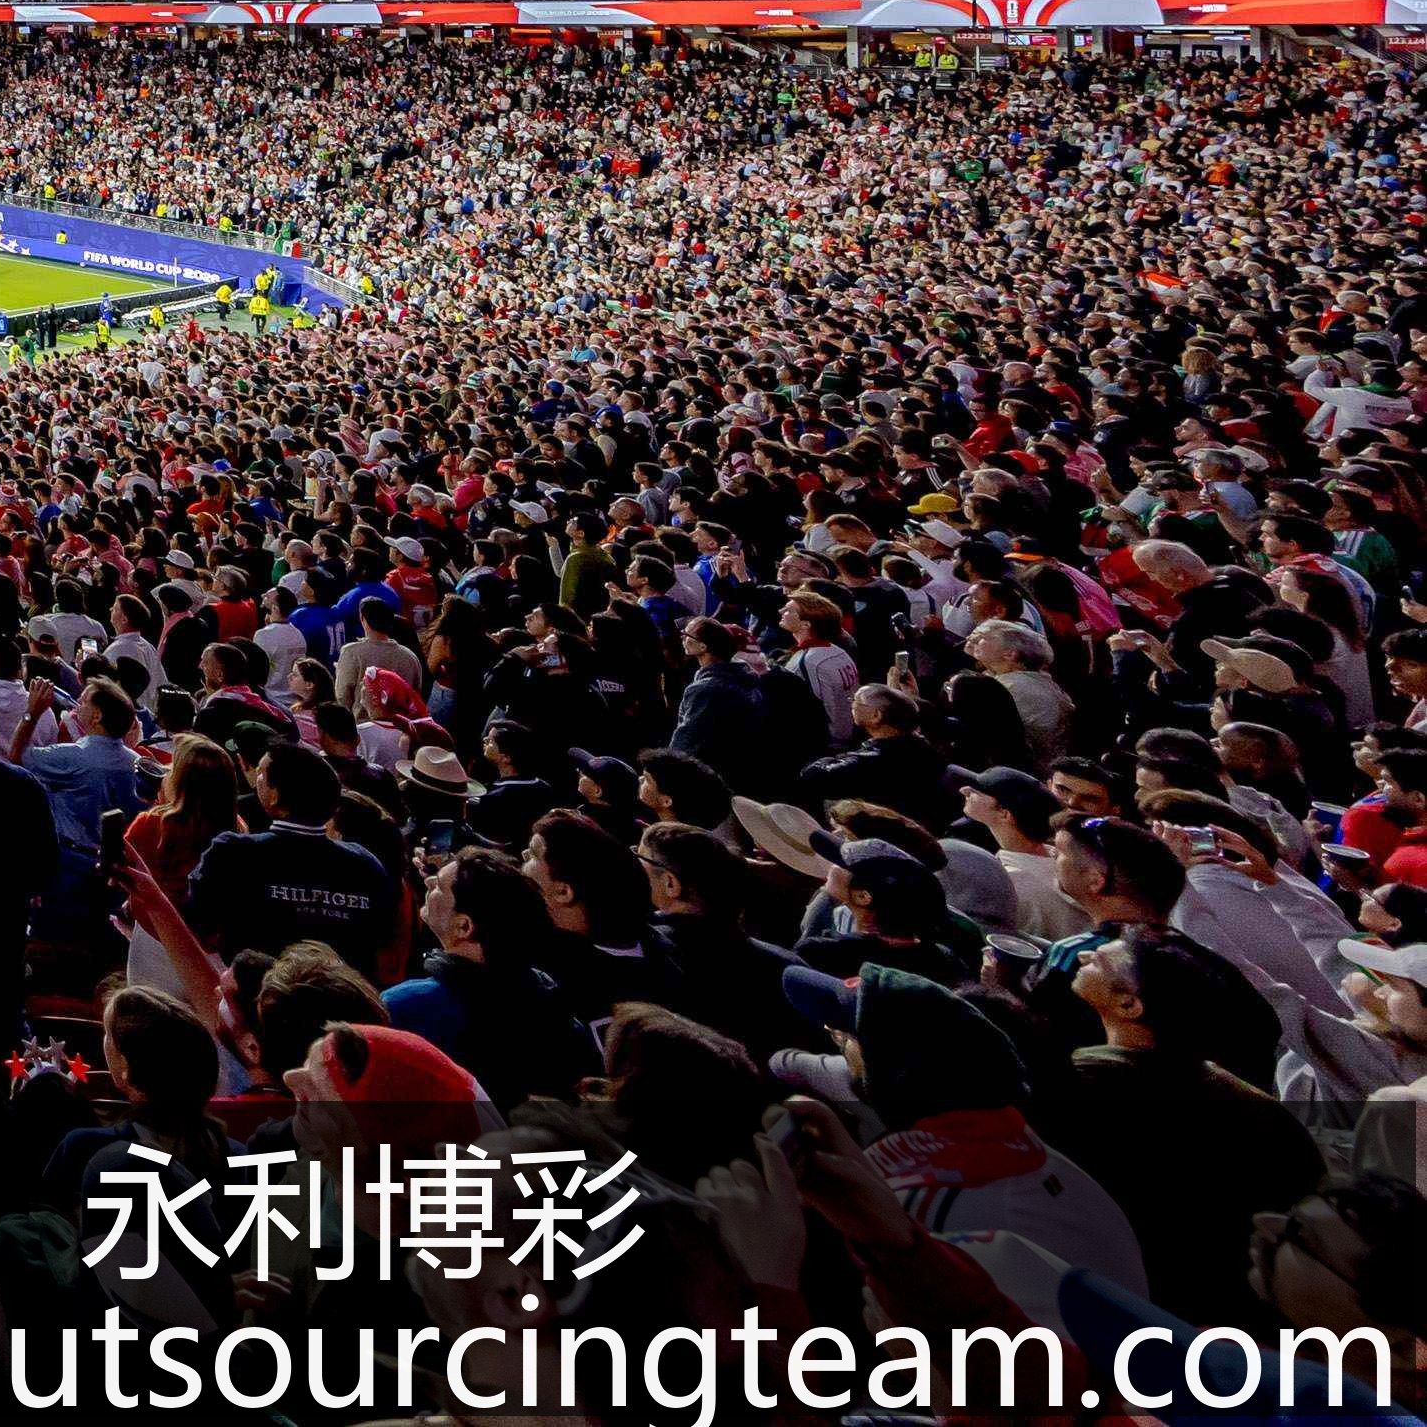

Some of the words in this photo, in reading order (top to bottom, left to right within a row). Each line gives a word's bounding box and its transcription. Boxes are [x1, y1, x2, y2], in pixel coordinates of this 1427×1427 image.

[83, 251, 109, 264] FIFA
[110, 255, 155, 272] WORLD
[156, 263, 182, 276] CUP
[270, 885, 370, 909] HILFIGER
